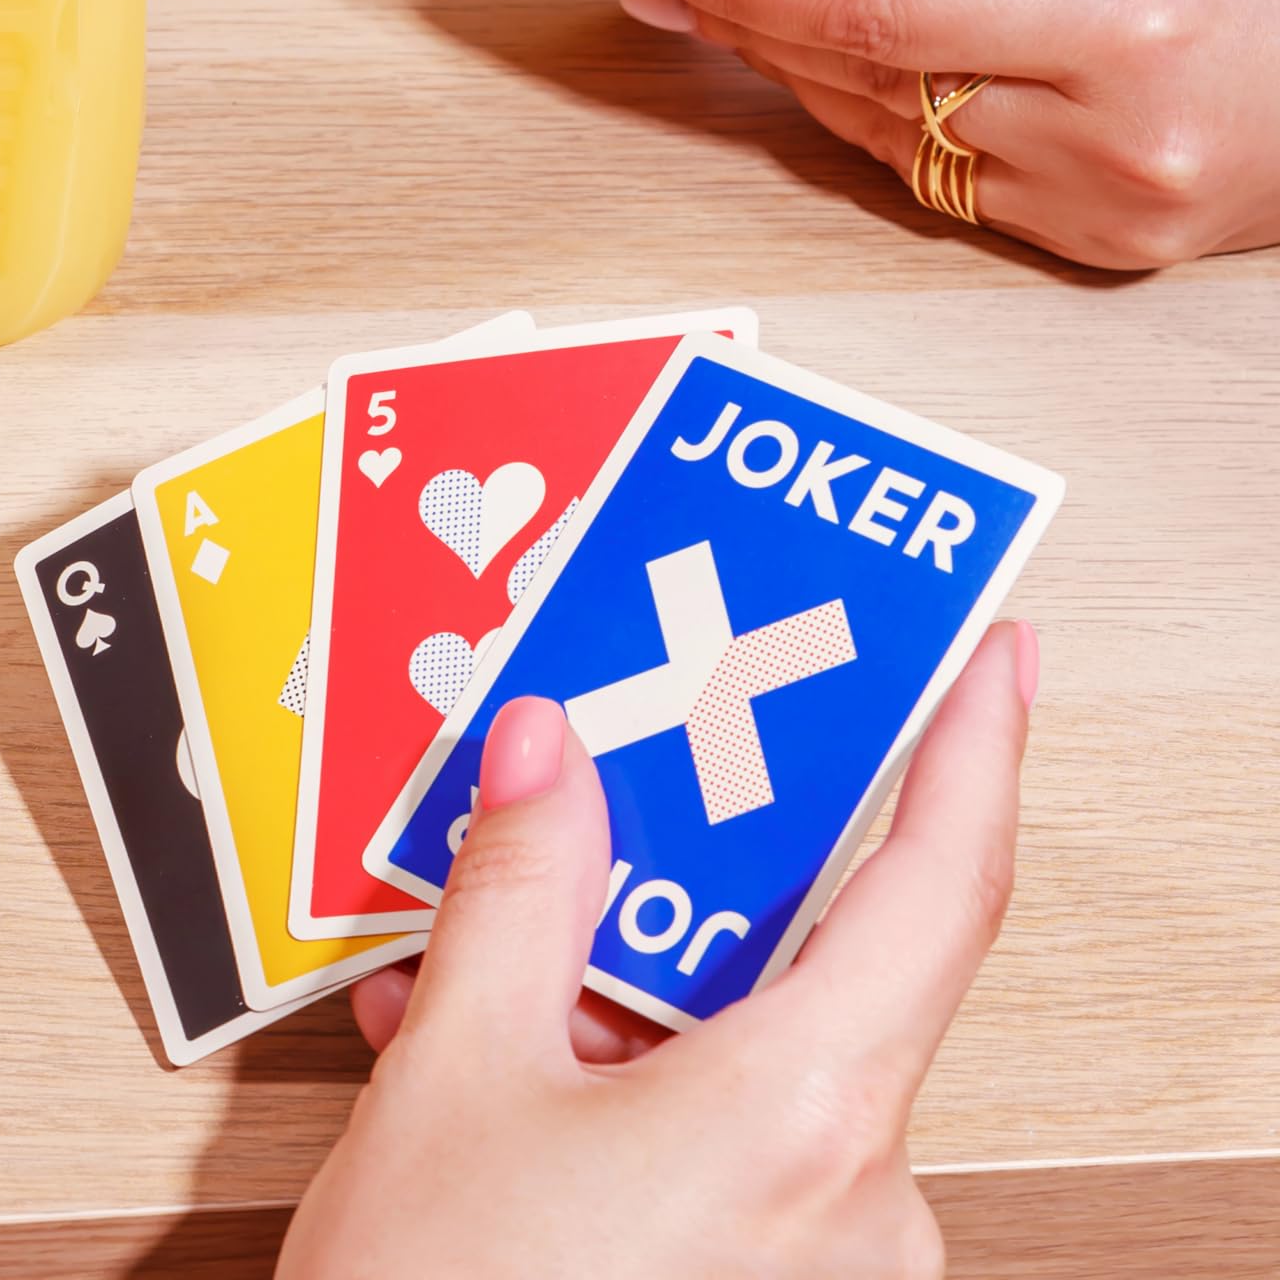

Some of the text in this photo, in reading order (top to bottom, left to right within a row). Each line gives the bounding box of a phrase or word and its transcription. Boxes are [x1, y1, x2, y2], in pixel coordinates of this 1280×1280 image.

[366, 390, 398, 436] 5
[670, 401, 976, 574] JOKER
[184, 490, 220, 537] A
[55, 559, 106, 606] Q
